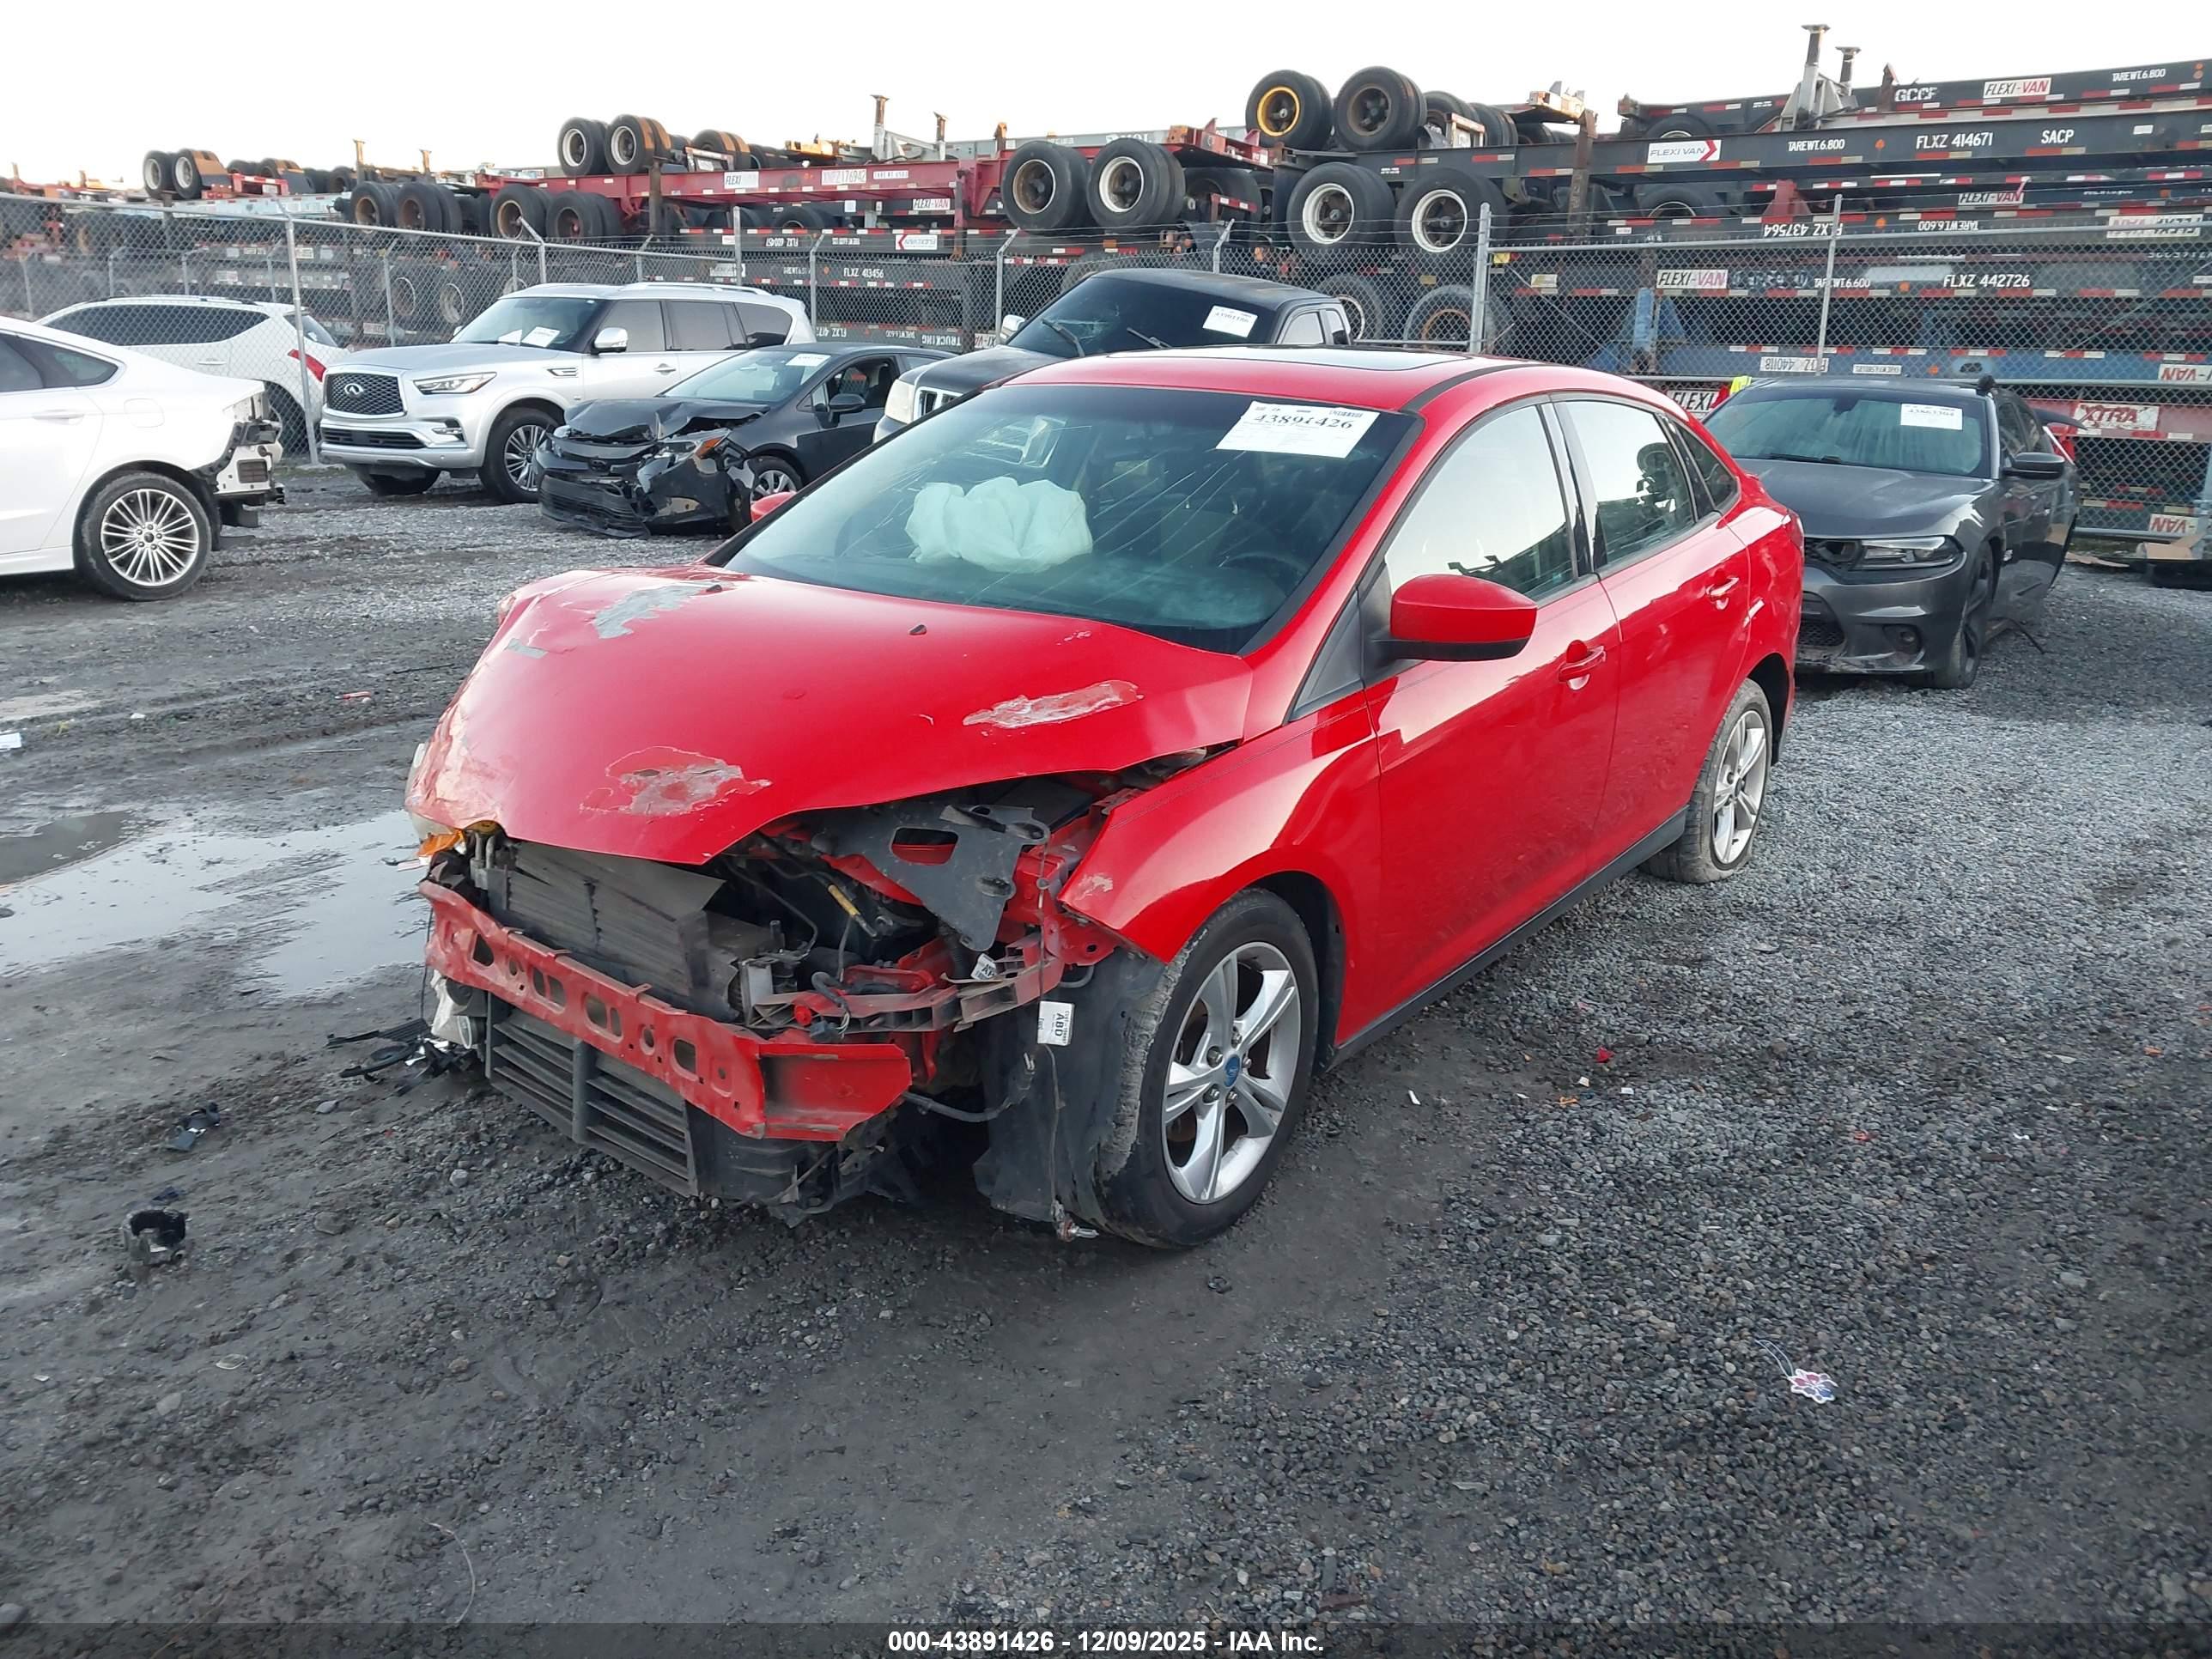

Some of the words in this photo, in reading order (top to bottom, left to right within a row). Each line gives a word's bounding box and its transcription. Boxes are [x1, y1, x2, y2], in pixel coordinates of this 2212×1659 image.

[1985, 81, 2049, 96] FLEXI-VAN
[1916, 134, 1949, 149] FLXZ
[1951, 131, 1993, 148] 414671
[2041, 129, 2075, 143] SACP
[1764, 222, 1808, 235] 437564
[1658, 272, 1725, 287] FLEXI-VAN
[1943, 275, 1975, 288] FLXZ
[1979, 274, 2030, 288] 442726
[921, 334, 961, 346] TRUCKING
[1255, 414, 1352, 429] 43891426
[1054, 1012, 1065, 1036] ABD
